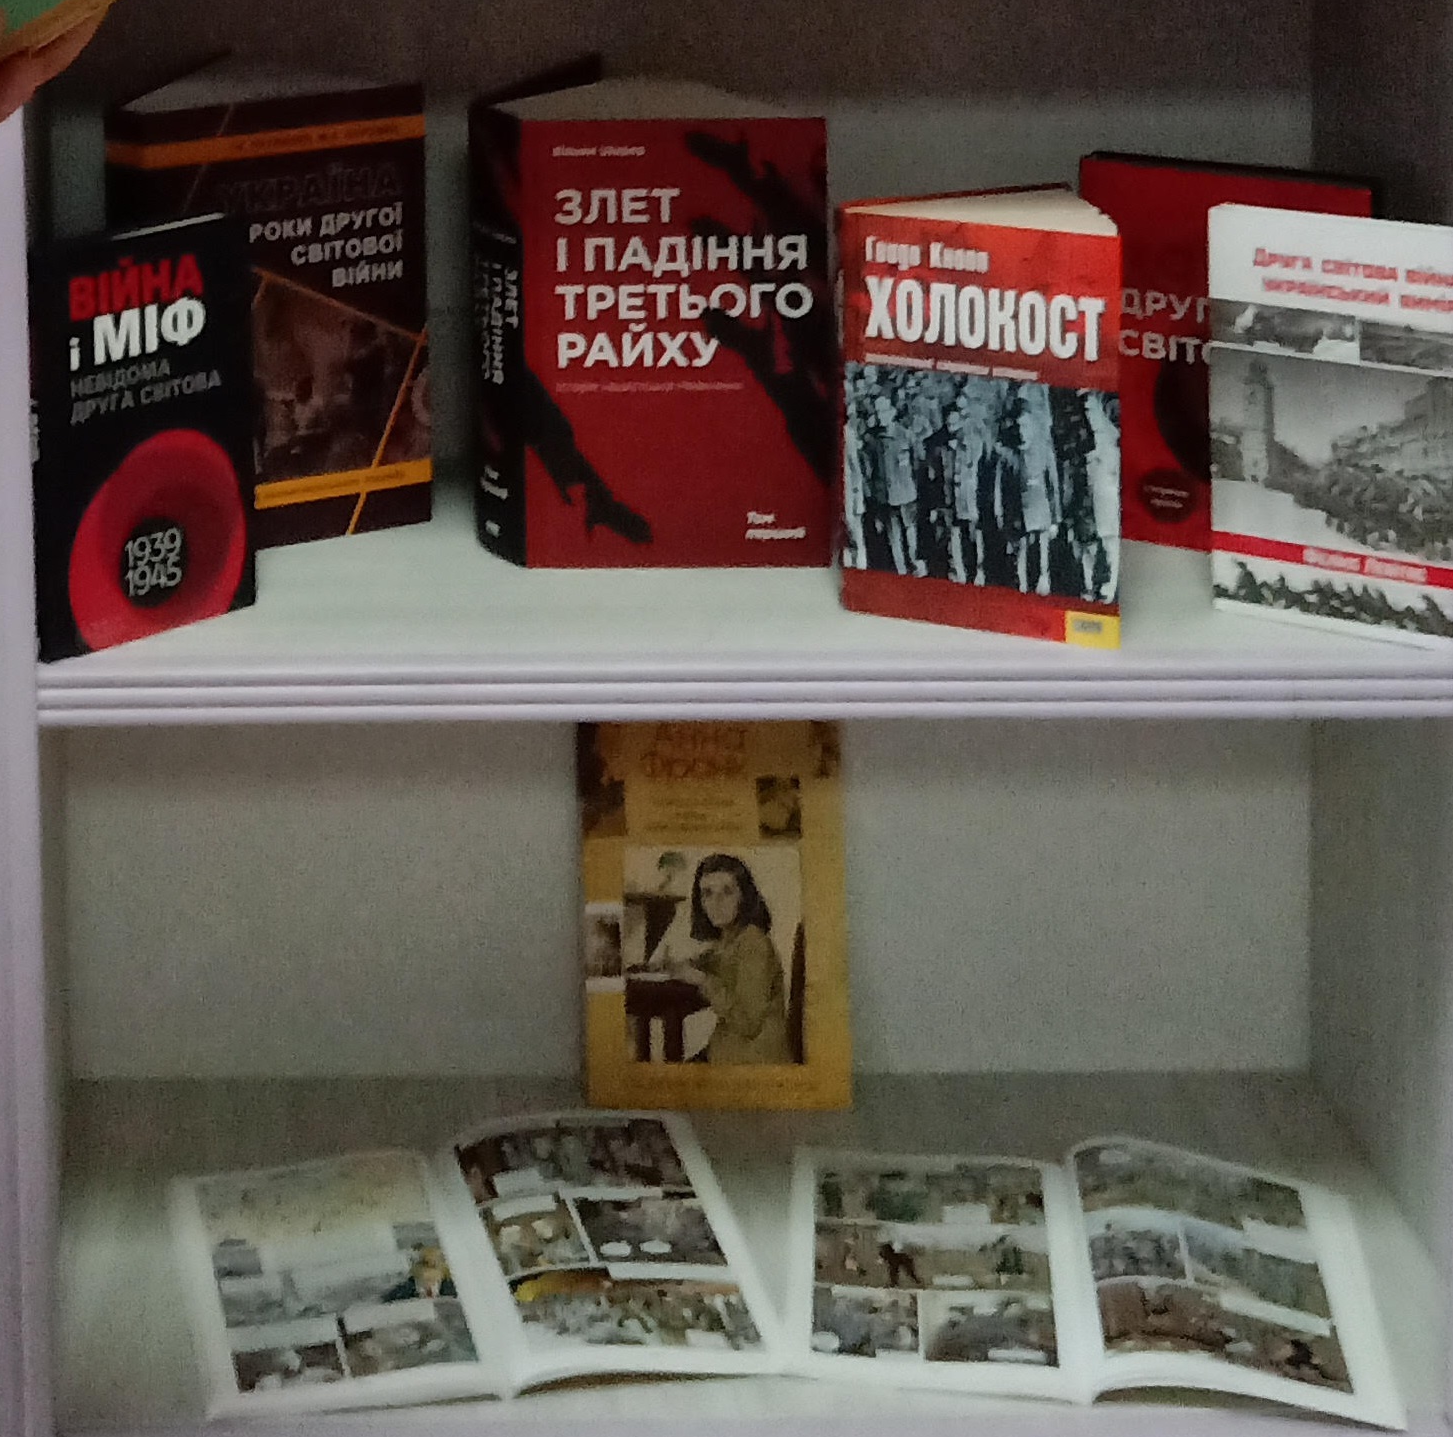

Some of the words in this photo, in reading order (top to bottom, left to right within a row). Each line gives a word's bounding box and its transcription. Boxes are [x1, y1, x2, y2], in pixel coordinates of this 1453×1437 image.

[249, 215, 313, 244] РОКИ
[319, 201, 404, 238] ДРУГОЇ
[554, 188, 681, 226] ЗЛЕТ
[290, 228, 404, 266] СВІТОВОЇ
[556, 237, 569, 272] І
[584, 233, 809, 279] ПАДІННЯ
[68, 252, 205, 323] ВІЙНА
[331, 259, 404, 288] ВІЙНИ
[554, 281, 815, 322] ТРЕТЬОГО
[864, 275, 1107, 362] ХОЛОКОСТ
[69, 336, 82, 372] і
[92, 295, 207, 367] МІФ
[557, 323, 720, 370] РАЙХУ
[69, 390, 136, 427] ДРУГА
[139, 368, 223, 406] СВІТОВА
[124, 527, 183, 568] 1939
[124, 555, 183, 598] 1945
